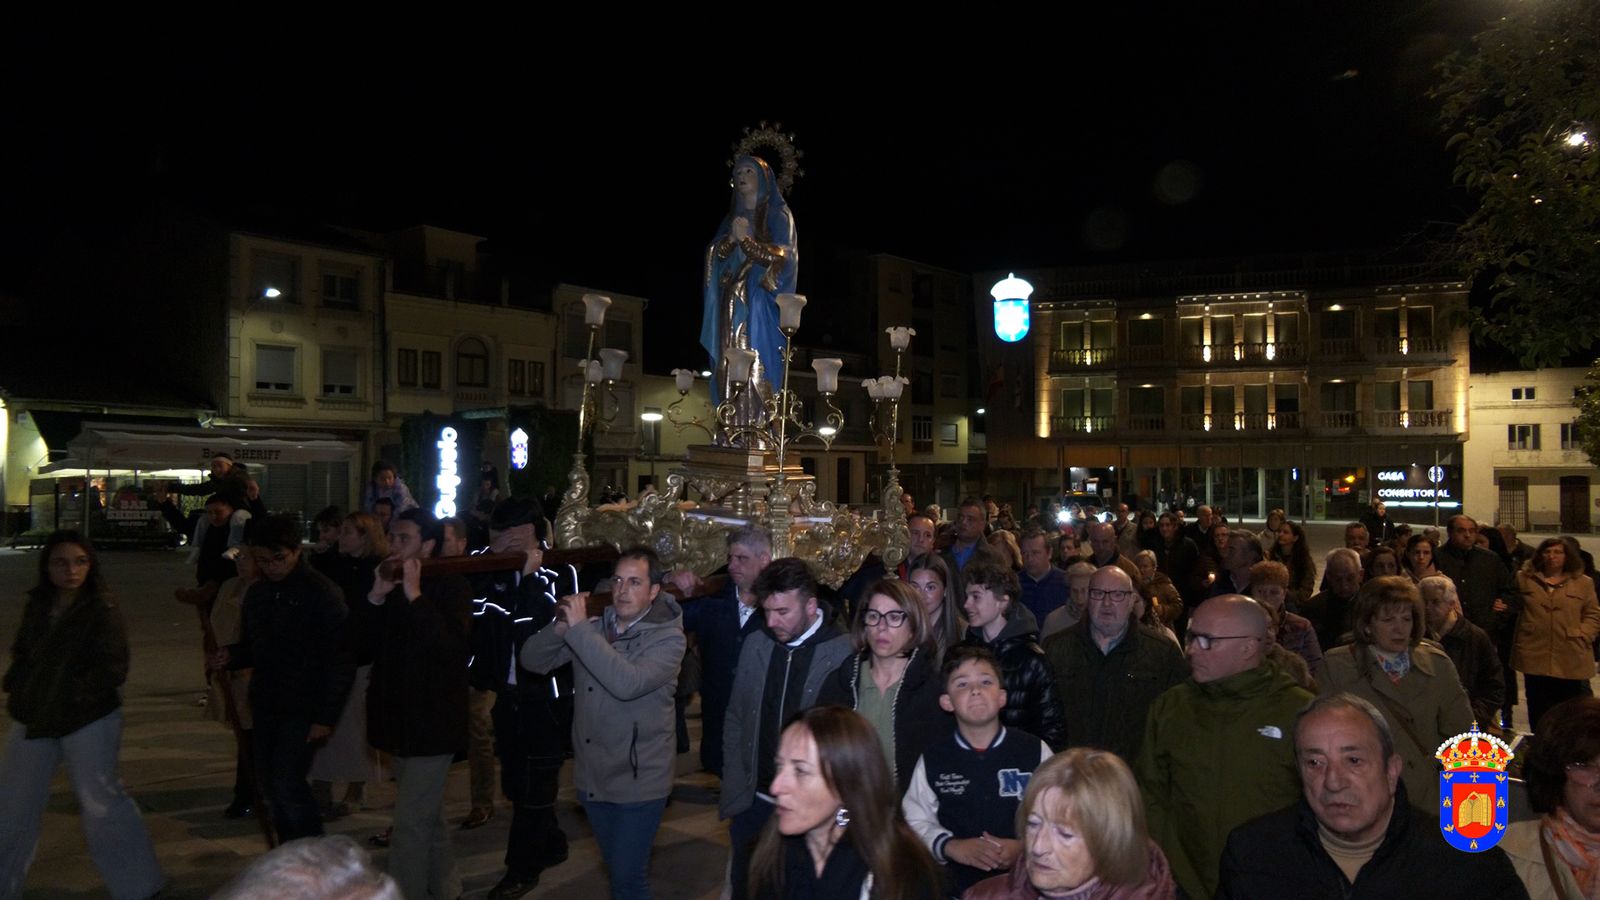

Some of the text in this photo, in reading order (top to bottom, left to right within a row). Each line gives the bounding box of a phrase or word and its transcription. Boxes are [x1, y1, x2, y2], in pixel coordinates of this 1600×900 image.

[233, 449, 281, 460] SHERIFF
[1377, 471, 1405, 481] CASA
[1377, 488, 1450, 498] CONSISTORAL
